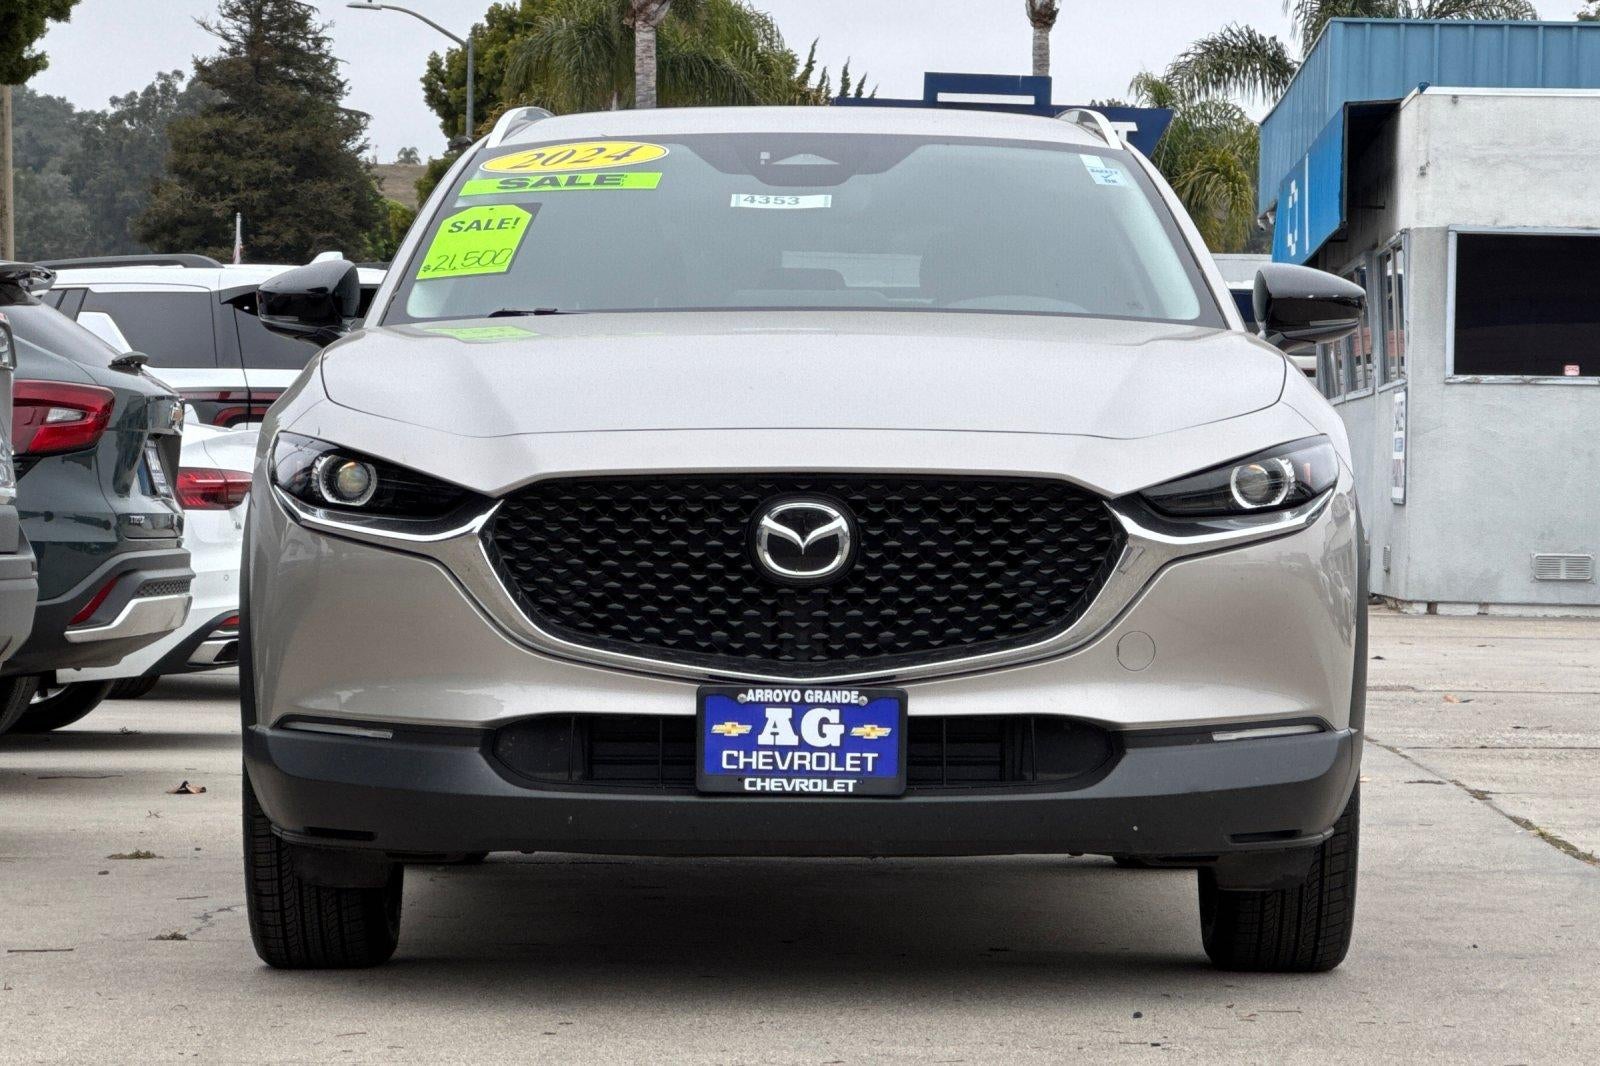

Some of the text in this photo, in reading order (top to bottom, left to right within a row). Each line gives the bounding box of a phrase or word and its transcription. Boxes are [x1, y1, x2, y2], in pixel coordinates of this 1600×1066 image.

[507, 145, 643, 170] 2024
[496, 174, 627, 190] SALE
[743, 195, 801, 206] 4353
[448, 217, 521, 233] SALE!
[747, 689, 859, 704] ARROYO GRANDE
[757, 707, 845, 748] AG
[721, 750, 879, 772] CHEVROLET
[744, 777, 857, 793] CHEVROLET
